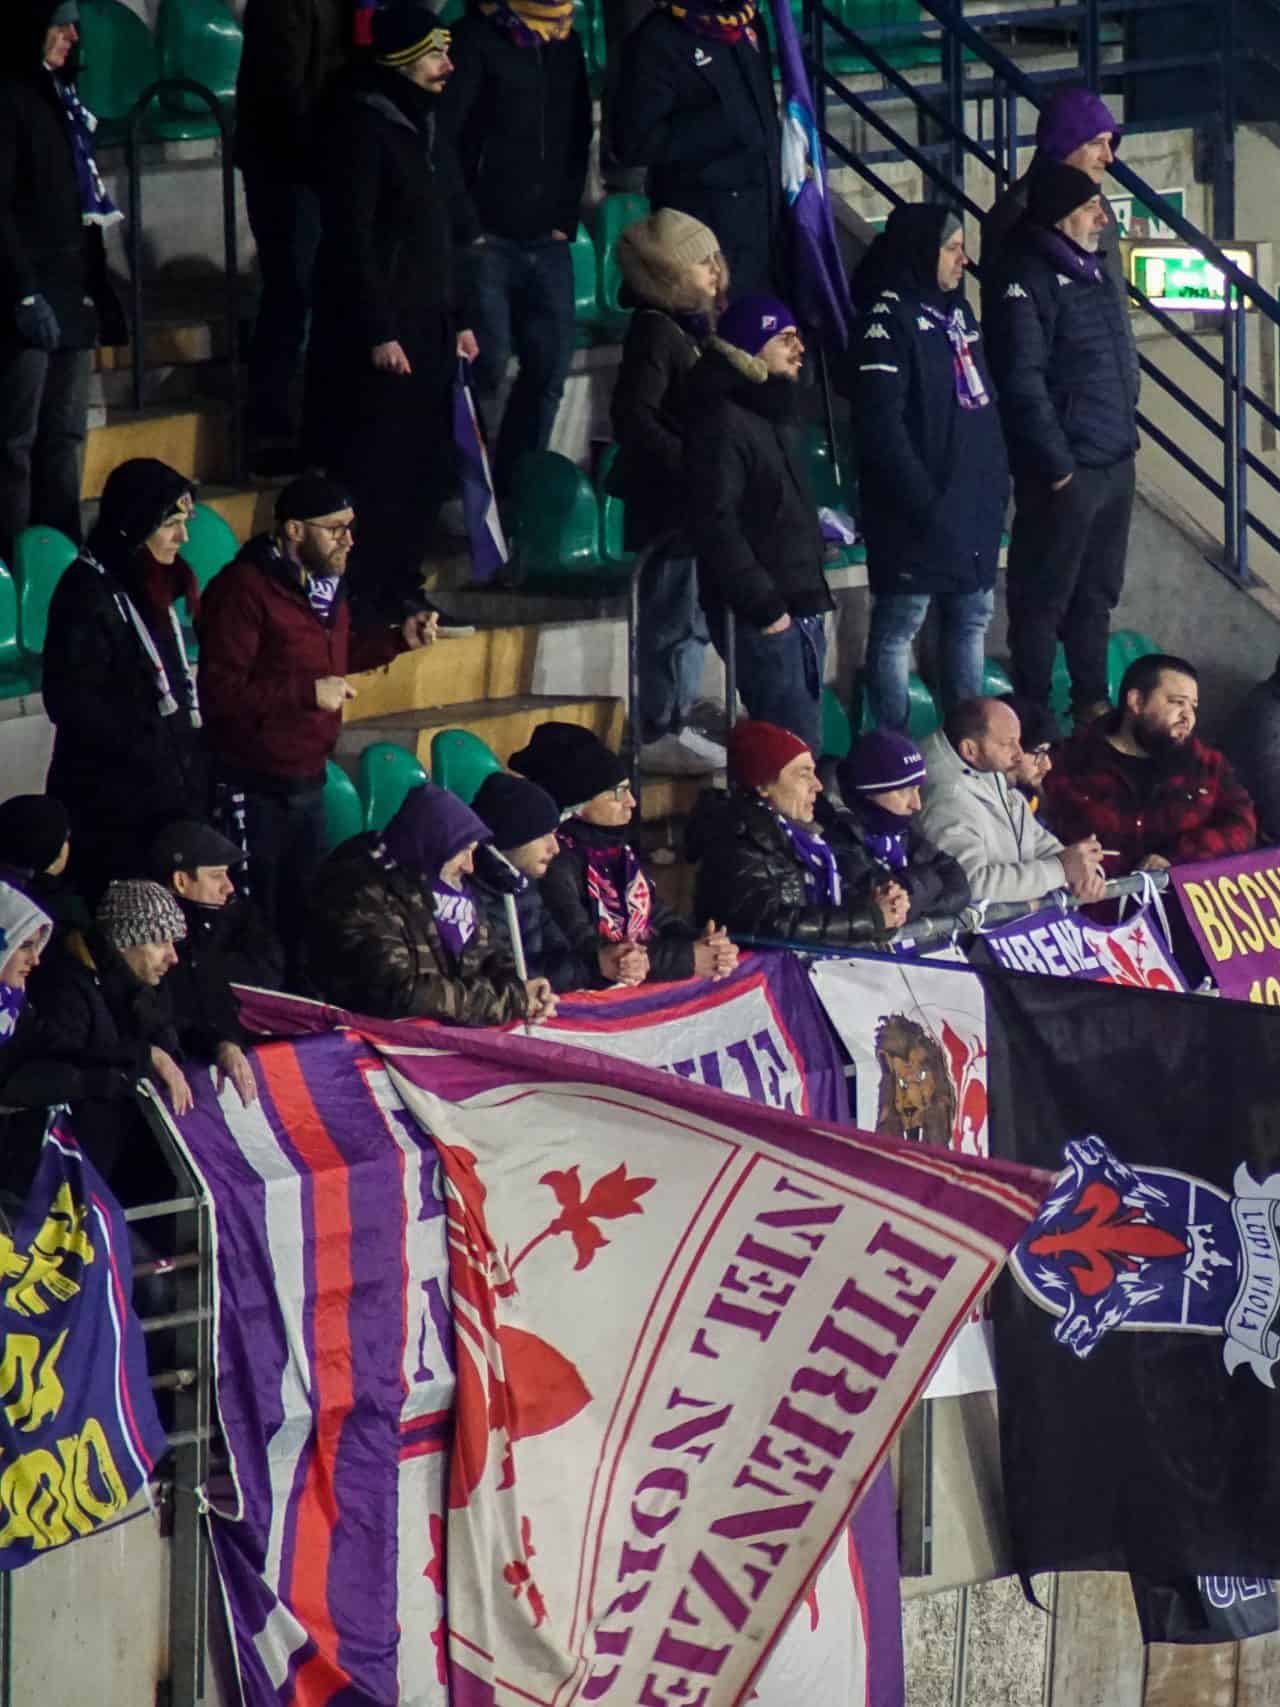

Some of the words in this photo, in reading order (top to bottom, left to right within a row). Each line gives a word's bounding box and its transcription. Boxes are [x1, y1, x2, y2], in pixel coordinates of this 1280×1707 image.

[689, 1175, 845, 1359] NEL
[1241, 1211, 1275, 1261] LUPI
[1237, 1274, 1275, 1331] VIOLA
[637, 1221, 957, 1707] FIRENZE
